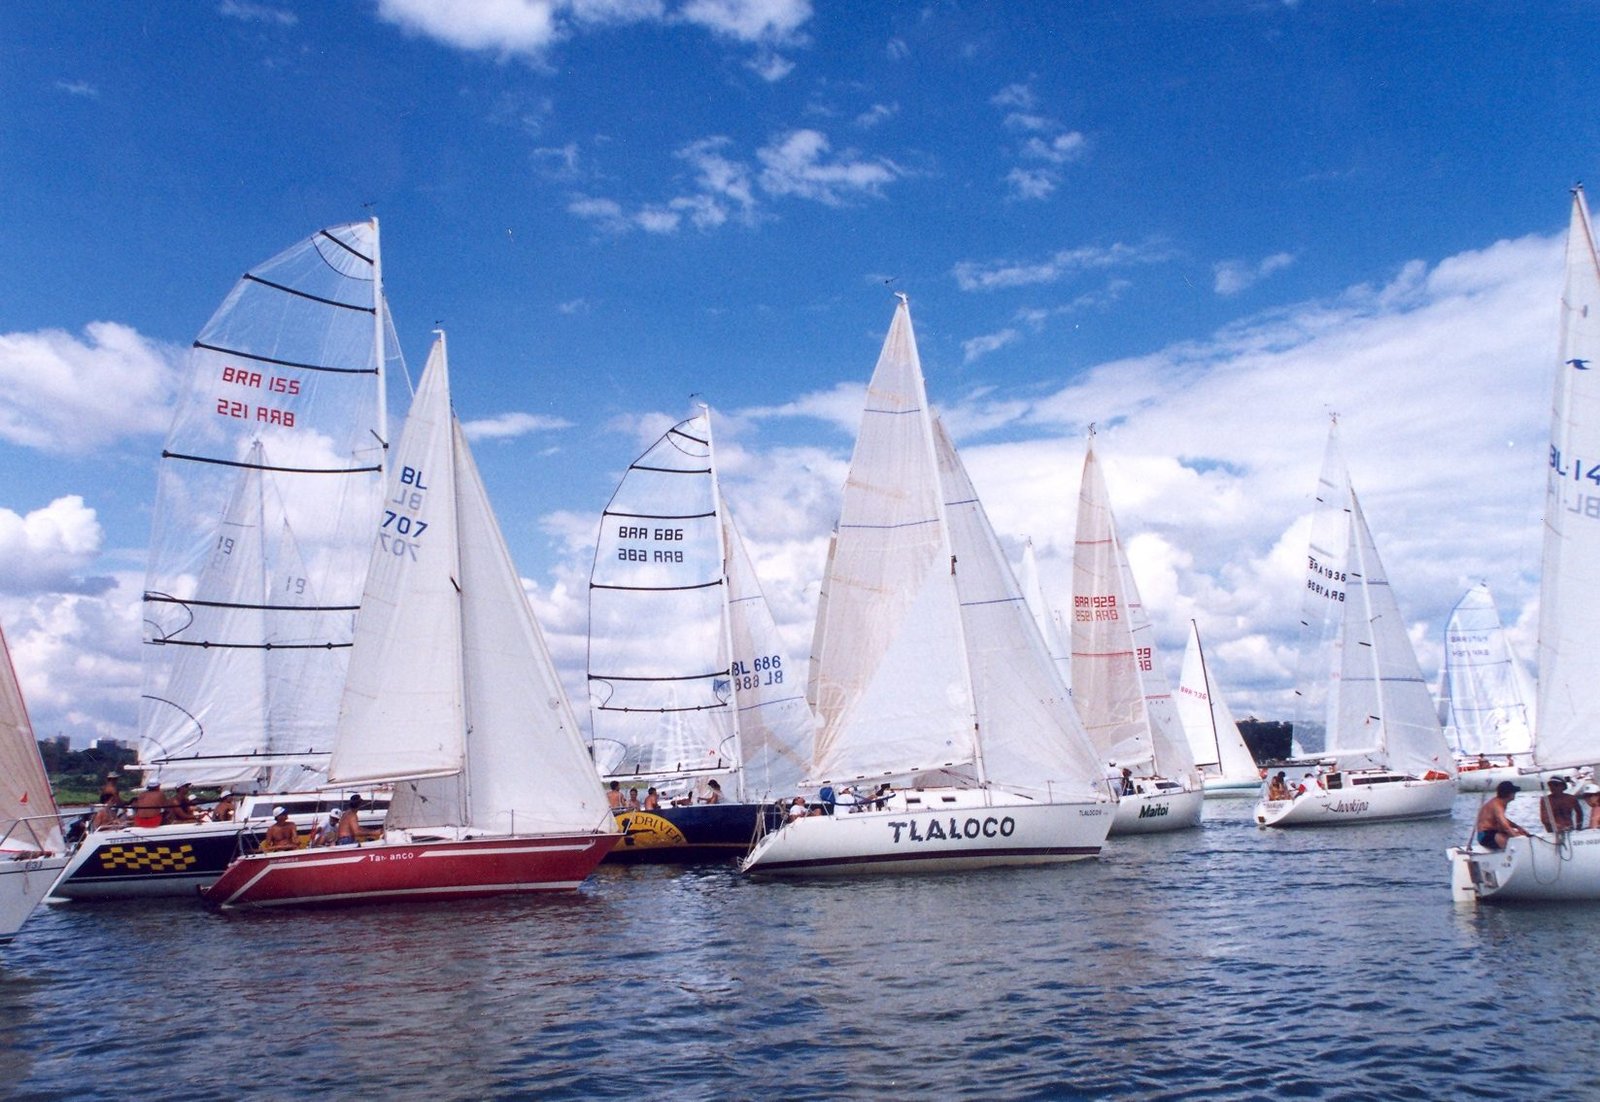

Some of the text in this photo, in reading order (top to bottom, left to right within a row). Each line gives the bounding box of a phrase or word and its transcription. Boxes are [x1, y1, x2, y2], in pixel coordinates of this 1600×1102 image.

[222, 367, 301, 395] BRA 155
[400, 466, 428, 490] BL
[382, 510, 428, 538] 707
[618, 526, 684, 541] BRA 686
[753, 655, 781, 672] 686
[1139, 803, 1169, 819] Maitoi
[634, 815, 683, 844] DRIVER
[888, 816, 1016, 844] TLALOCO
